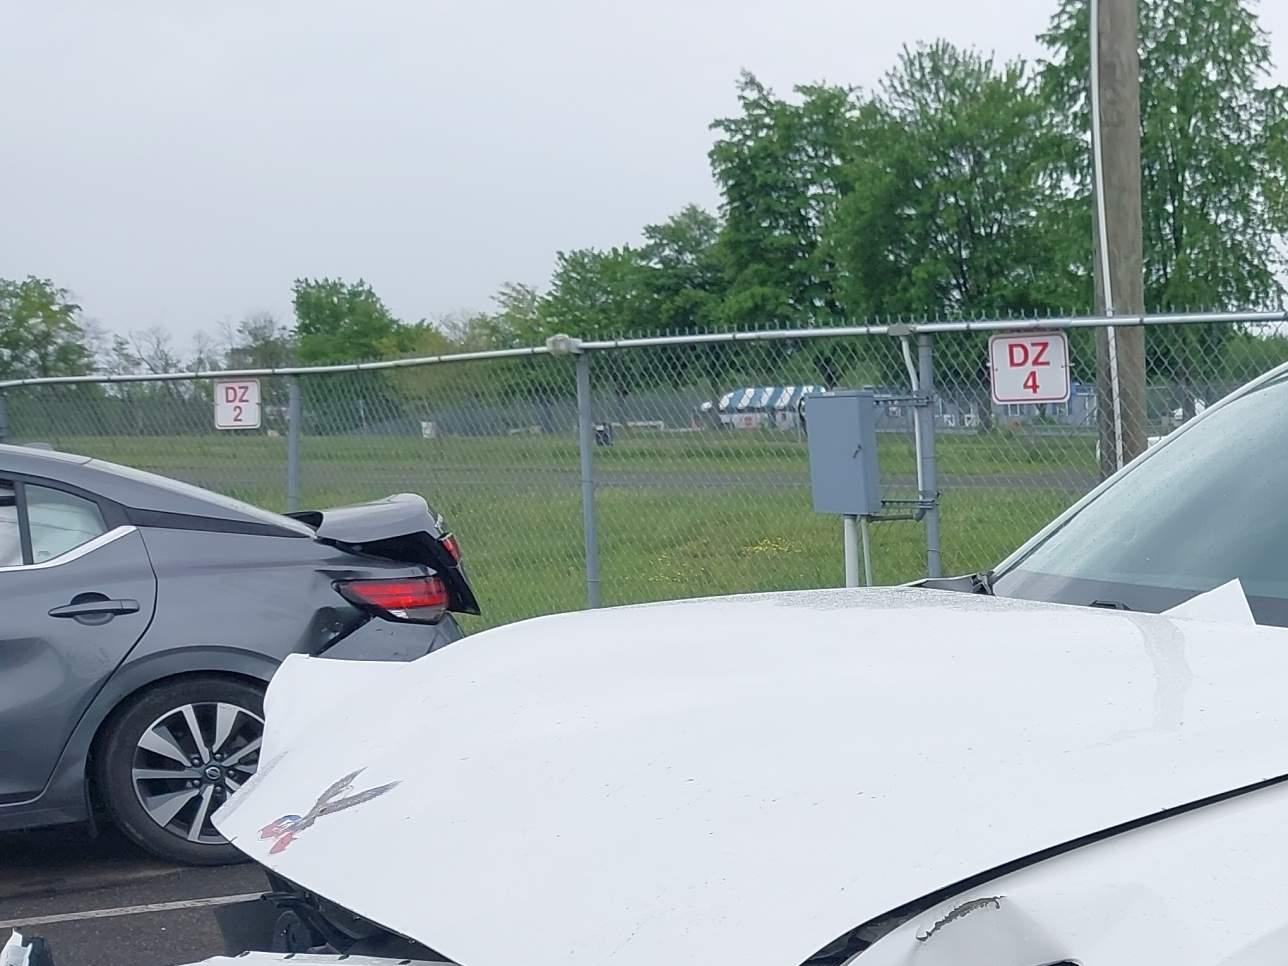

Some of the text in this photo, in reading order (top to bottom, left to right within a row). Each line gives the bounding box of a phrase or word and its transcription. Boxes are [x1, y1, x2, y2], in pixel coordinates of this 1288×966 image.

[1007, 341, 1051, 368] DZ
[1022, 370, 1040, 394] 4
[225, 385, 249, 404] DZ
[233, 405, 243, 422] 2
